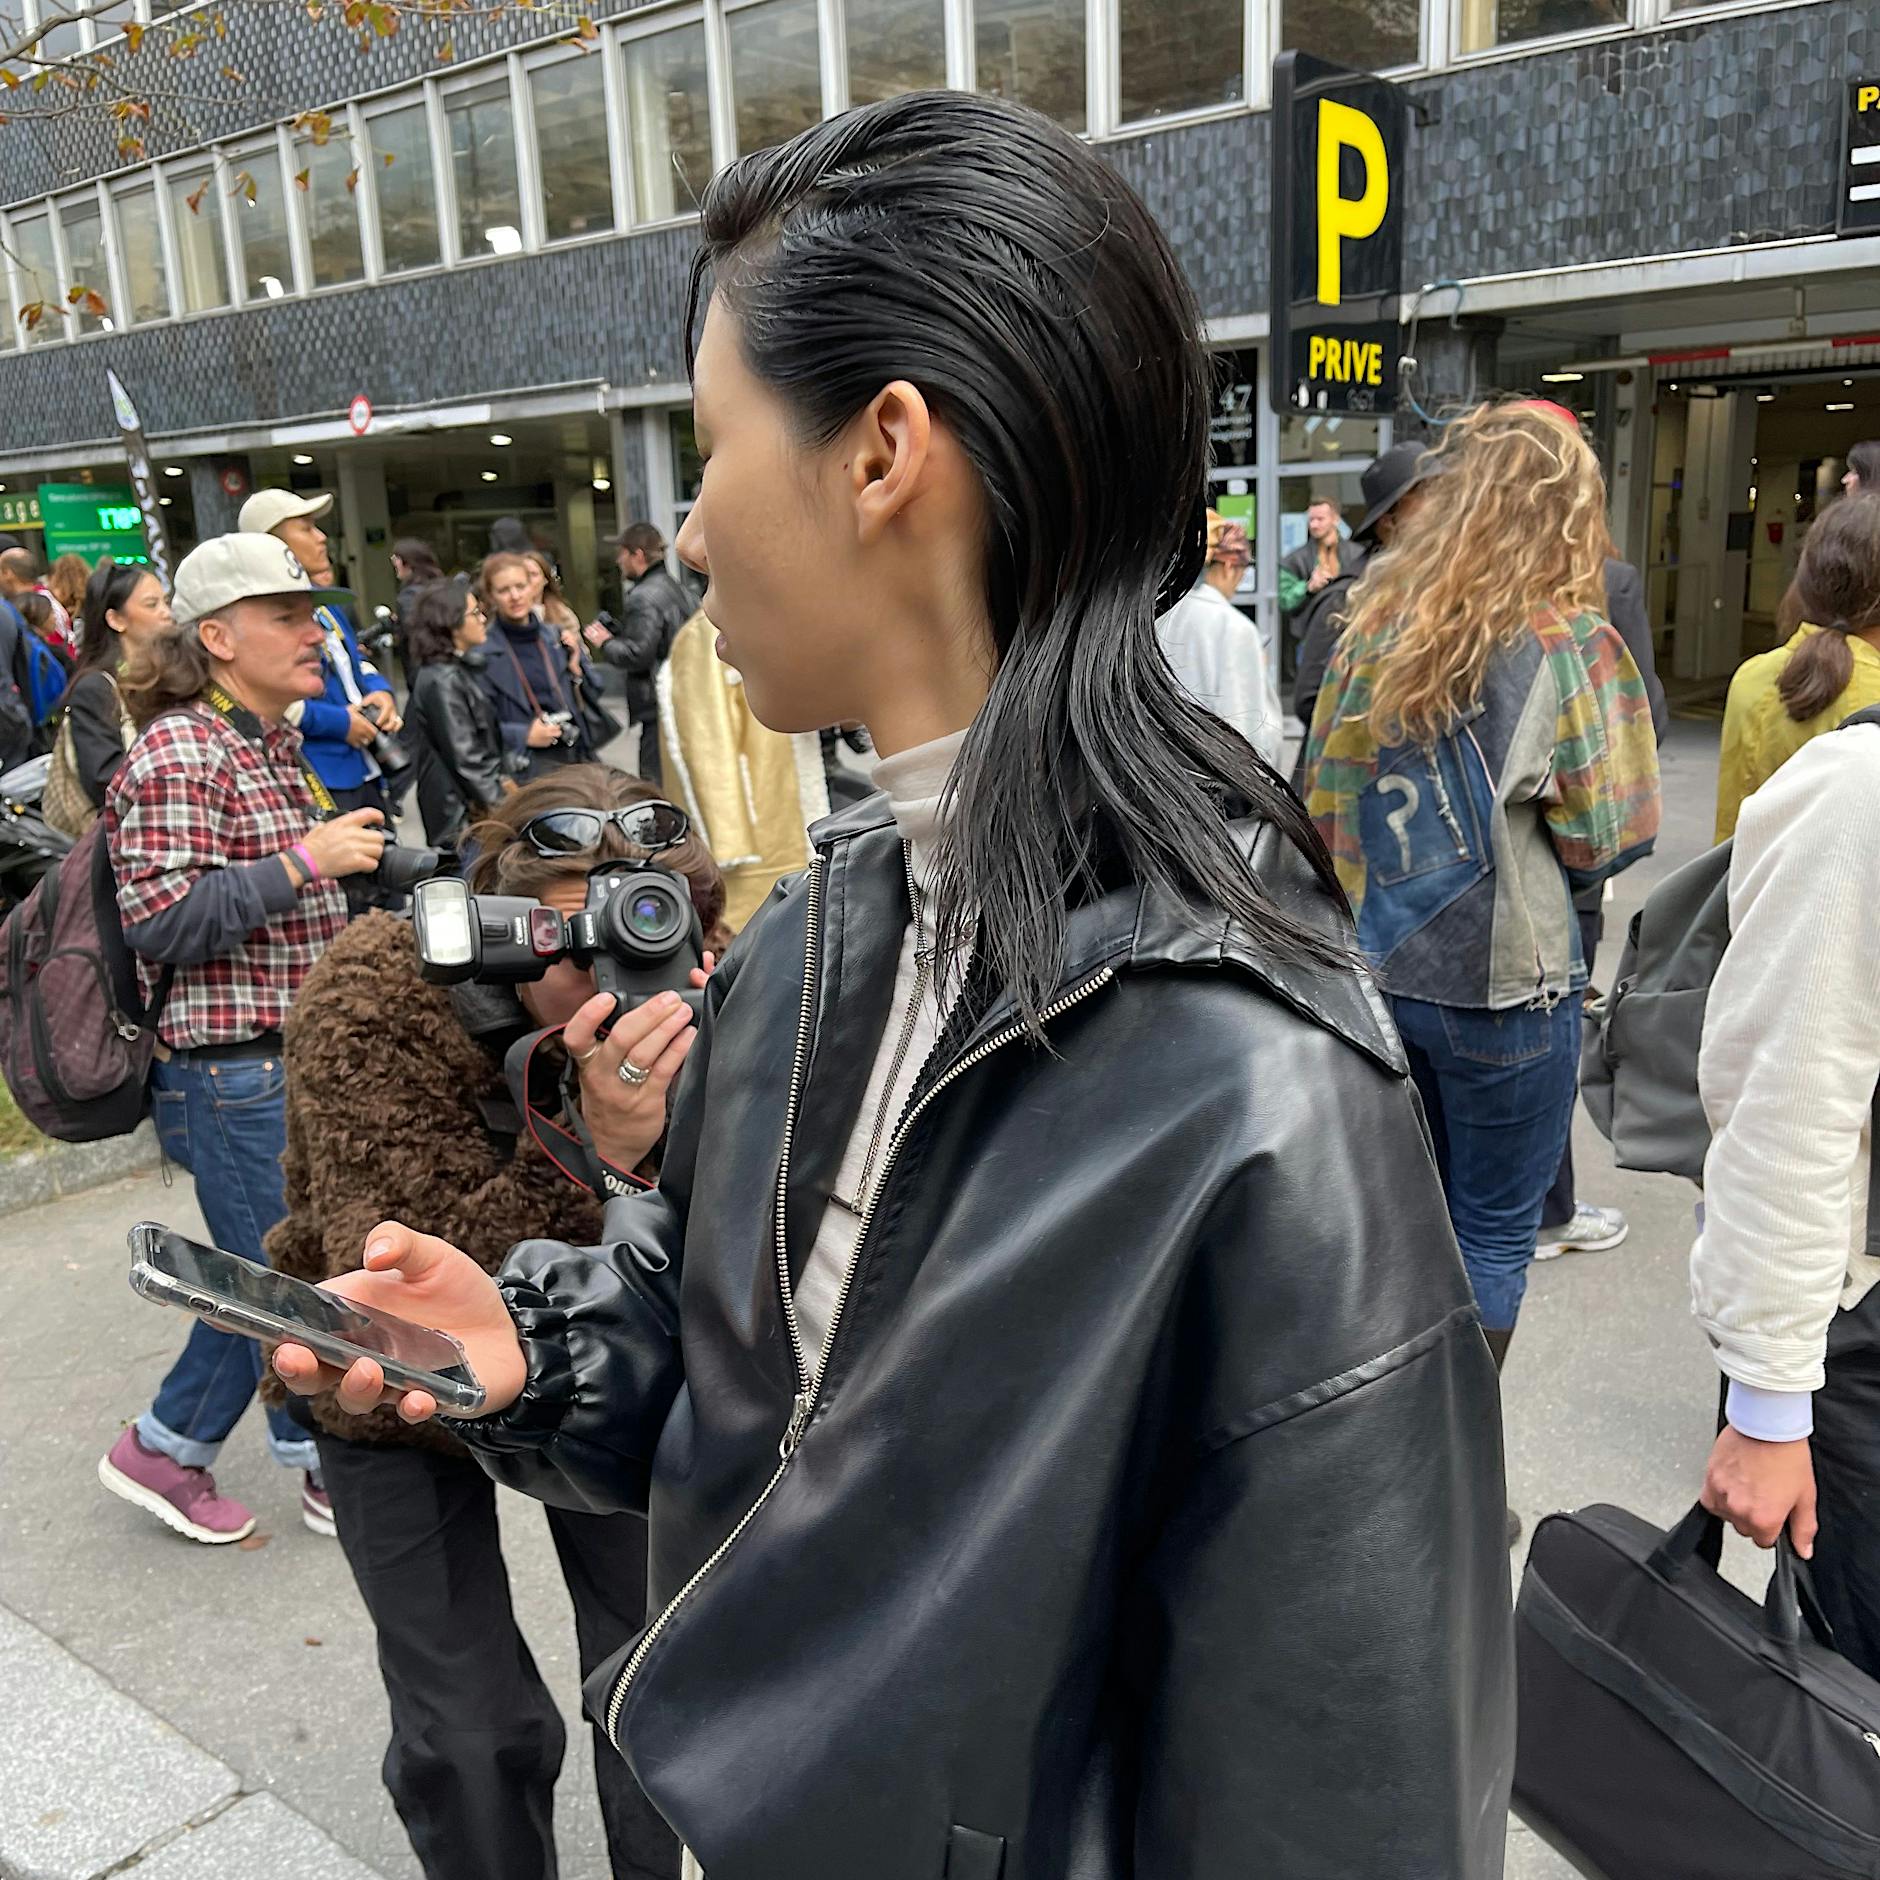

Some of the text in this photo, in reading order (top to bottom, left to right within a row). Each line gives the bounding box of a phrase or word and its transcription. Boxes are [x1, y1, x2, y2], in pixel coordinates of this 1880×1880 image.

[1858, 86, 1880, 112] P
[1317, 98, 1389, 305] P
[1309, 336, 1383, 384] PRIVE
